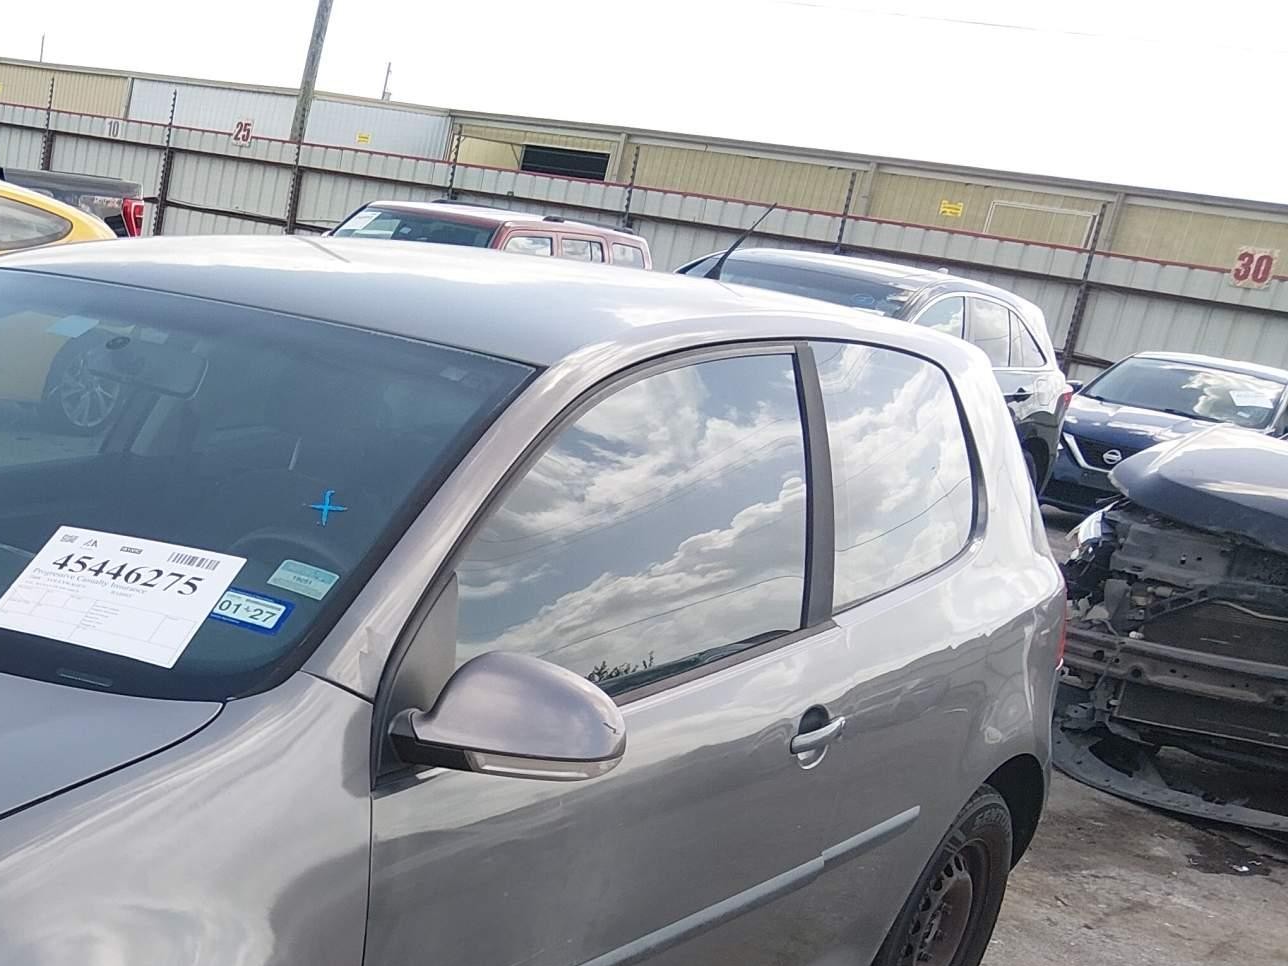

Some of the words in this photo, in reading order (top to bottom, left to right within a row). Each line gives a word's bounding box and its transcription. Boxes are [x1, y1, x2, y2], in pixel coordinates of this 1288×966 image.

[108, 120, 120, 138] 10
[233, 121, 252, 143] 25
[1233, 251, 1274, 284] 30
[52, 553, 204, 596] 45446275
[218, 600, 242, 615] 01
[248, 608, 278, 623] 27
